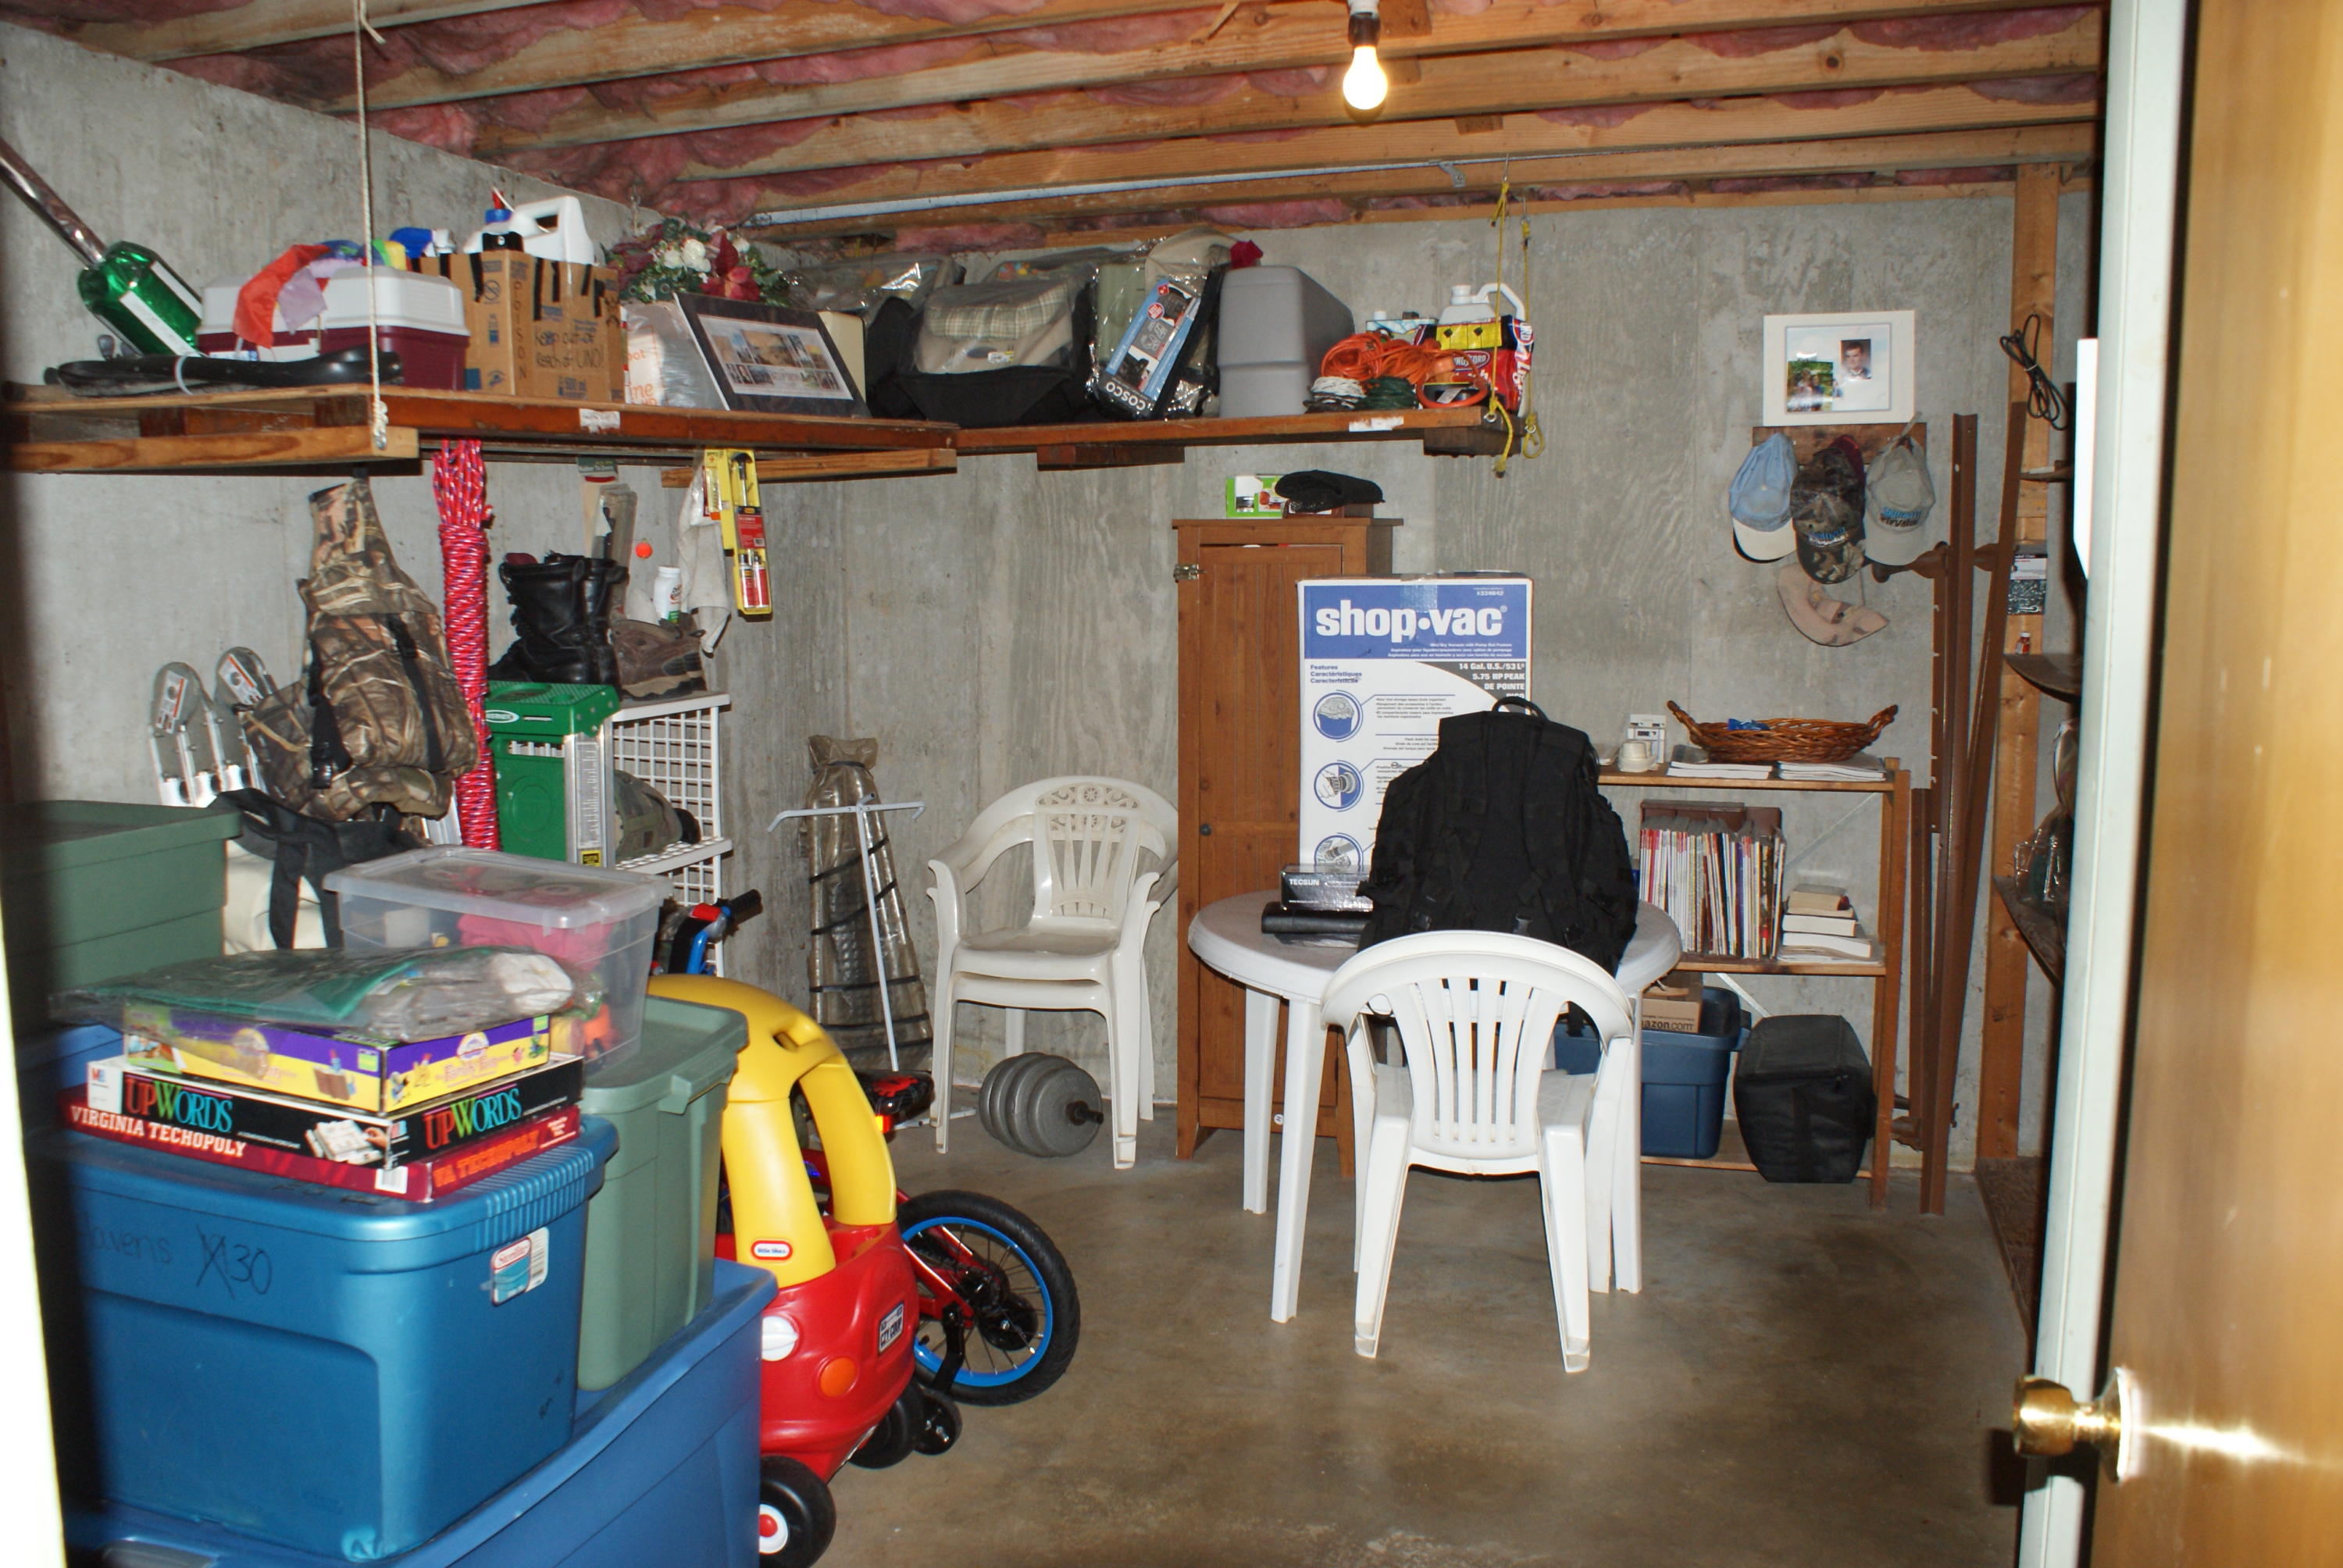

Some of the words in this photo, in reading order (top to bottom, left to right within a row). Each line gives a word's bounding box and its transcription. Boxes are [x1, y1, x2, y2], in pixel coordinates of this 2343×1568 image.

[1105, 381, 1146, 411] COSCO
[1642, 1020, 1694, 1032] azon.com
[70, 1105, 145, 1137] VIRGINIA
[148, 1121, 248, 1157] TECHOPOLY
[123, 1078, 234, 1133] UPWORDS
[424, 1087, 522, 1149] UPWORDS
